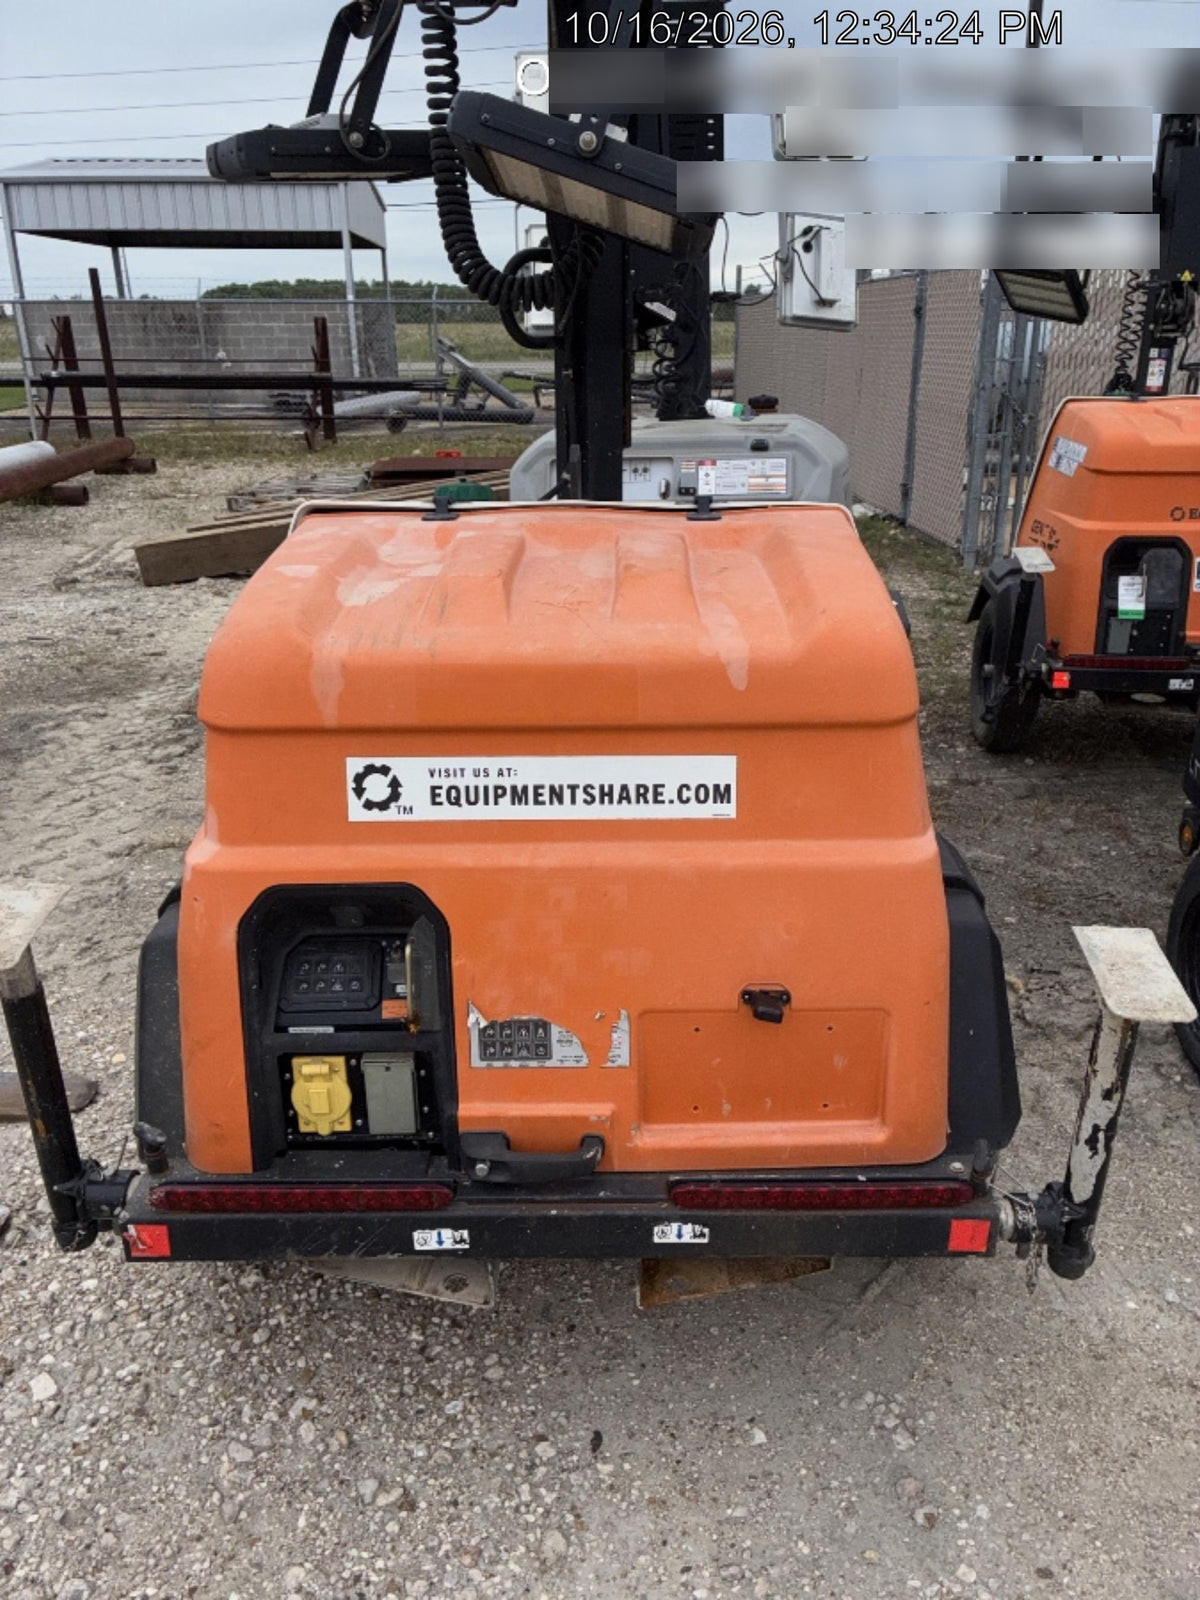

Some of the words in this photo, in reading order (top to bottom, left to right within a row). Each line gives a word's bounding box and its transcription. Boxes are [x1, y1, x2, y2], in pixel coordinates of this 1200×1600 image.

[427, 767, 466, 779] VISIT
[472, 767, 490, 779] US
[496, 767, 518, 779] AT:
[429, 783, 732, 808] EQUIPMENTSHARE.COM
[395, 805, 414, 816] TM
